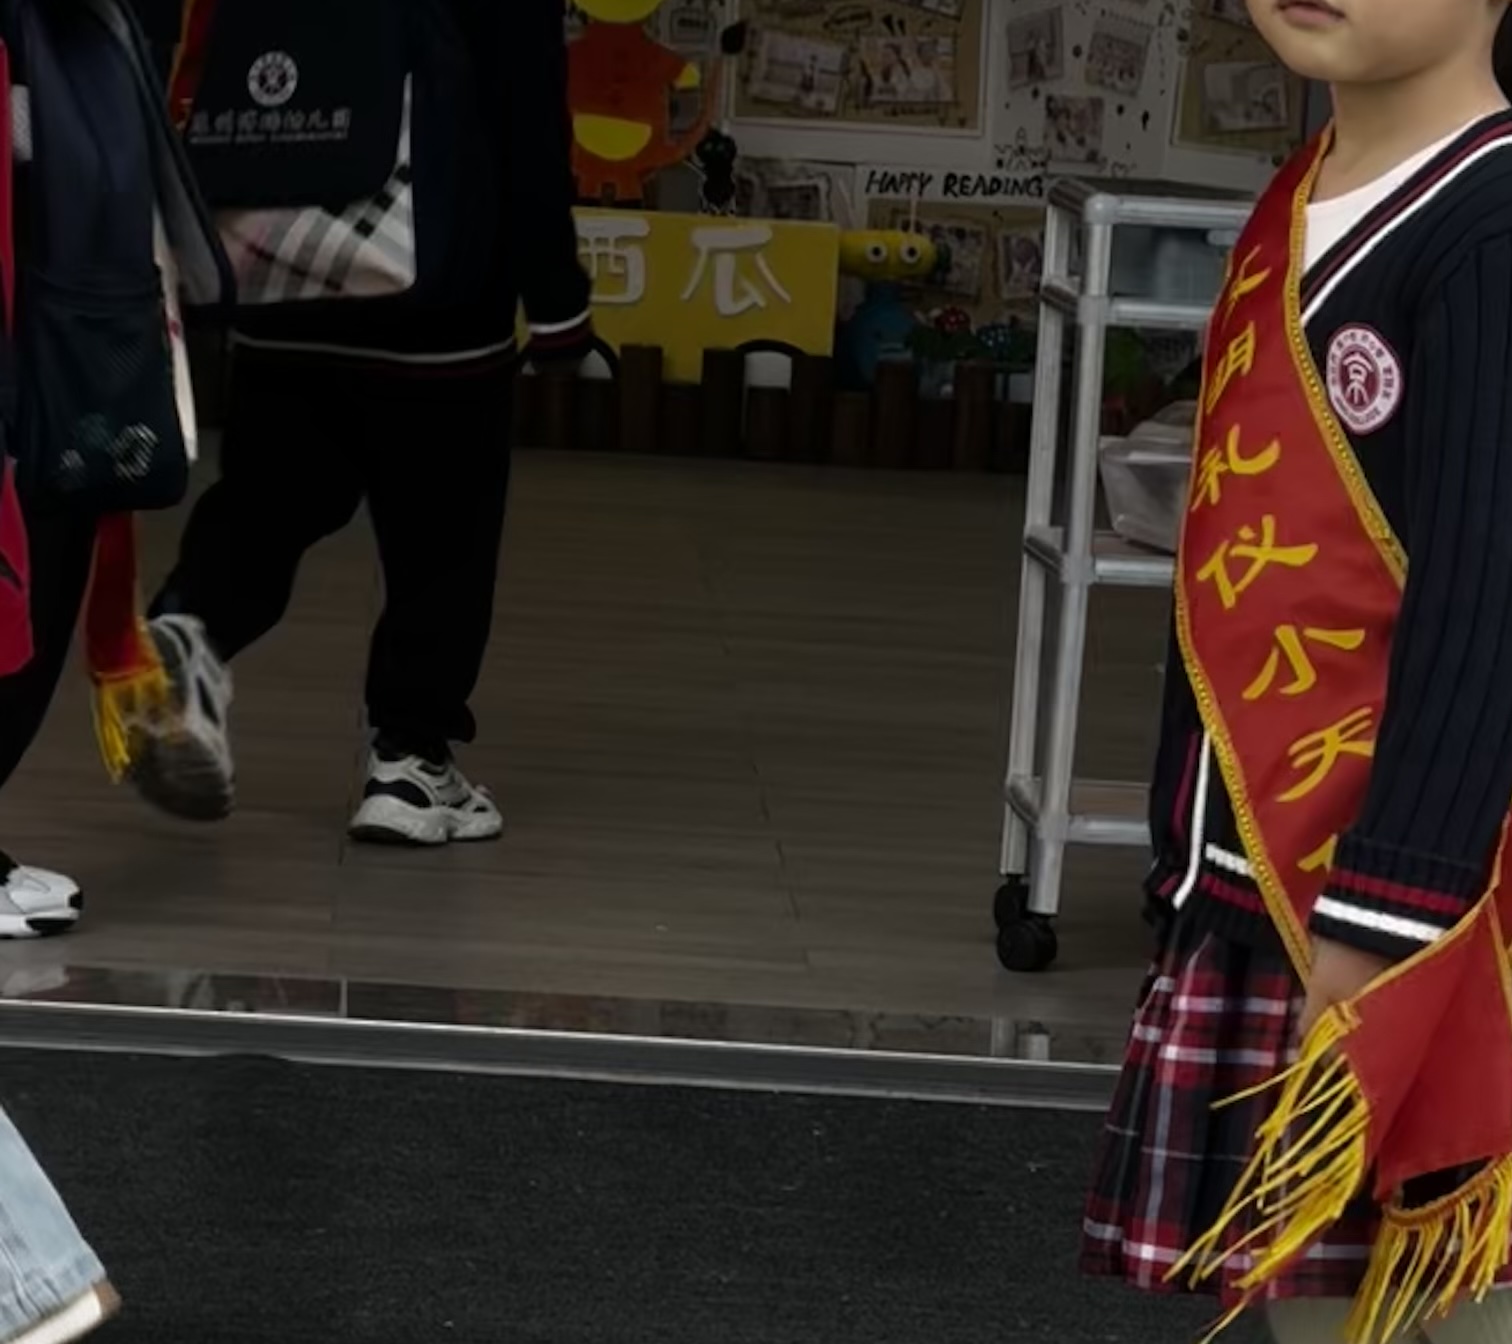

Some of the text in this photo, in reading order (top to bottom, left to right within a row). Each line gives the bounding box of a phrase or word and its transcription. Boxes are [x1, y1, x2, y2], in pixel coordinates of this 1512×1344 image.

[943, 172, 1044, 198] READING
[574, 215, 793, 318] 西瓜
[1188, 242, 1375, 873] 文明礼仪小天
